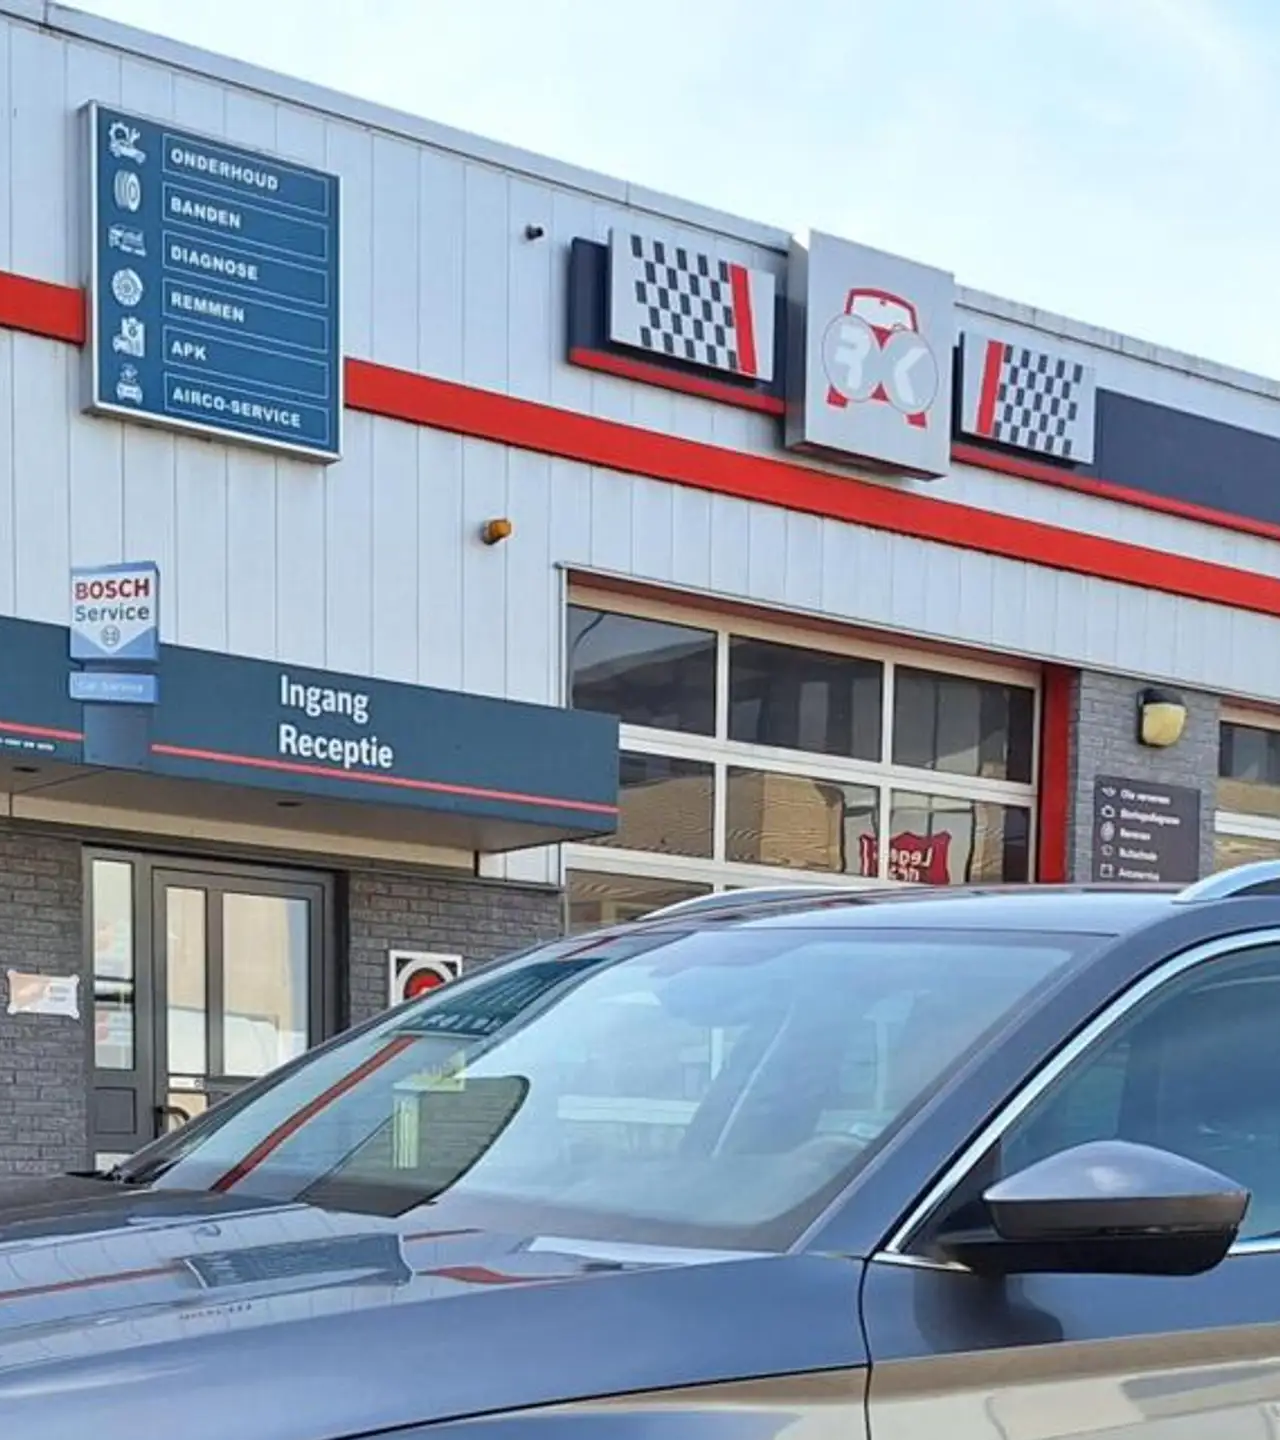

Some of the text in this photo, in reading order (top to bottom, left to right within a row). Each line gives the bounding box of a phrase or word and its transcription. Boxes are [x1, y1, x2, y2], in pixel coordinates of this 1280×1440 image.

[170, 148, 278, 190] ONDERHOUD
[170, 196, 241, 228] BANDEN
[170, 245, 258, 280] DIAGNOSE
[171, 291, 245, 323] REMMEN
[171, 340, 207, 361] APK
[172, 386, 301, 427] AIRCO-SERVICE
[74, 578, 150, 600] BOSCH
[74, 602, 150, 621] Service
[281, 674, 369, 724] Ingang
[280, 723, 394, 769] Receptie
